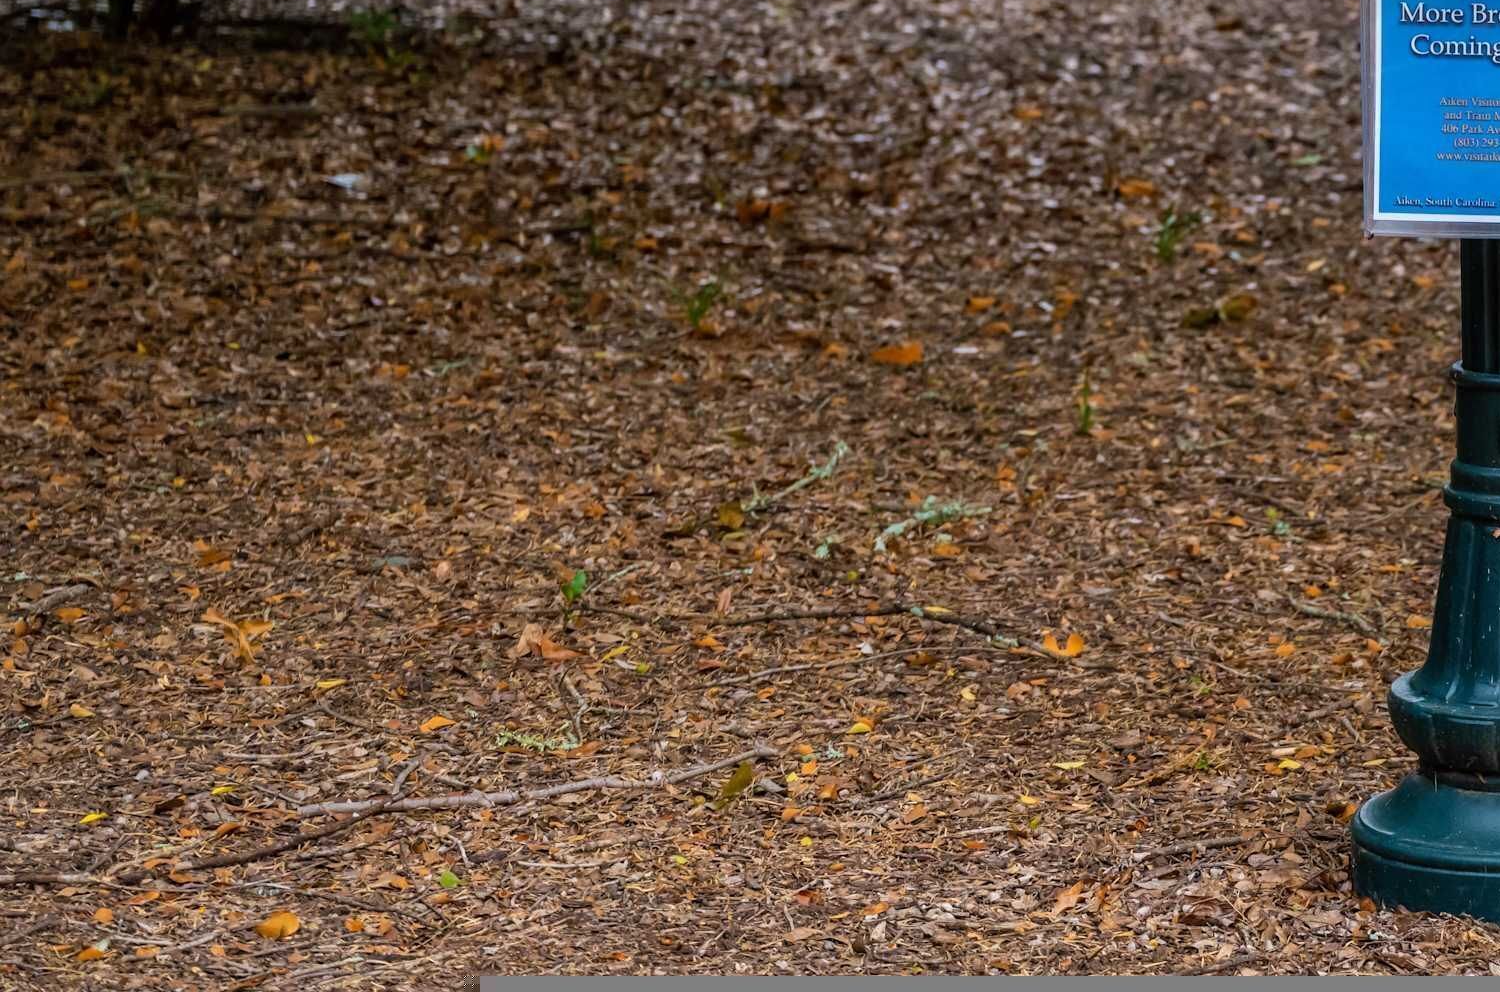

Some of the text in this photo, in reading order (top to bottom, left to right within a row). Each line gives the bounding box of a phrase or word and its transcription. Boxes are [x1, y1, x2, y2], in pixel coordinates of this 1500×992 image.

[1400, 2, 1464, 24] More
[1439, 96, 1467, 107] Aiken
[1444, 110, 1462, 120] and
[1465, 110, 1490, 121] Train
[1441, 123, 1459, 134] 406
[1461, 124, 1483, 135] Park
[1453, 137, 1479, 148] (803)
[1425, 195, 1453, 207] South
